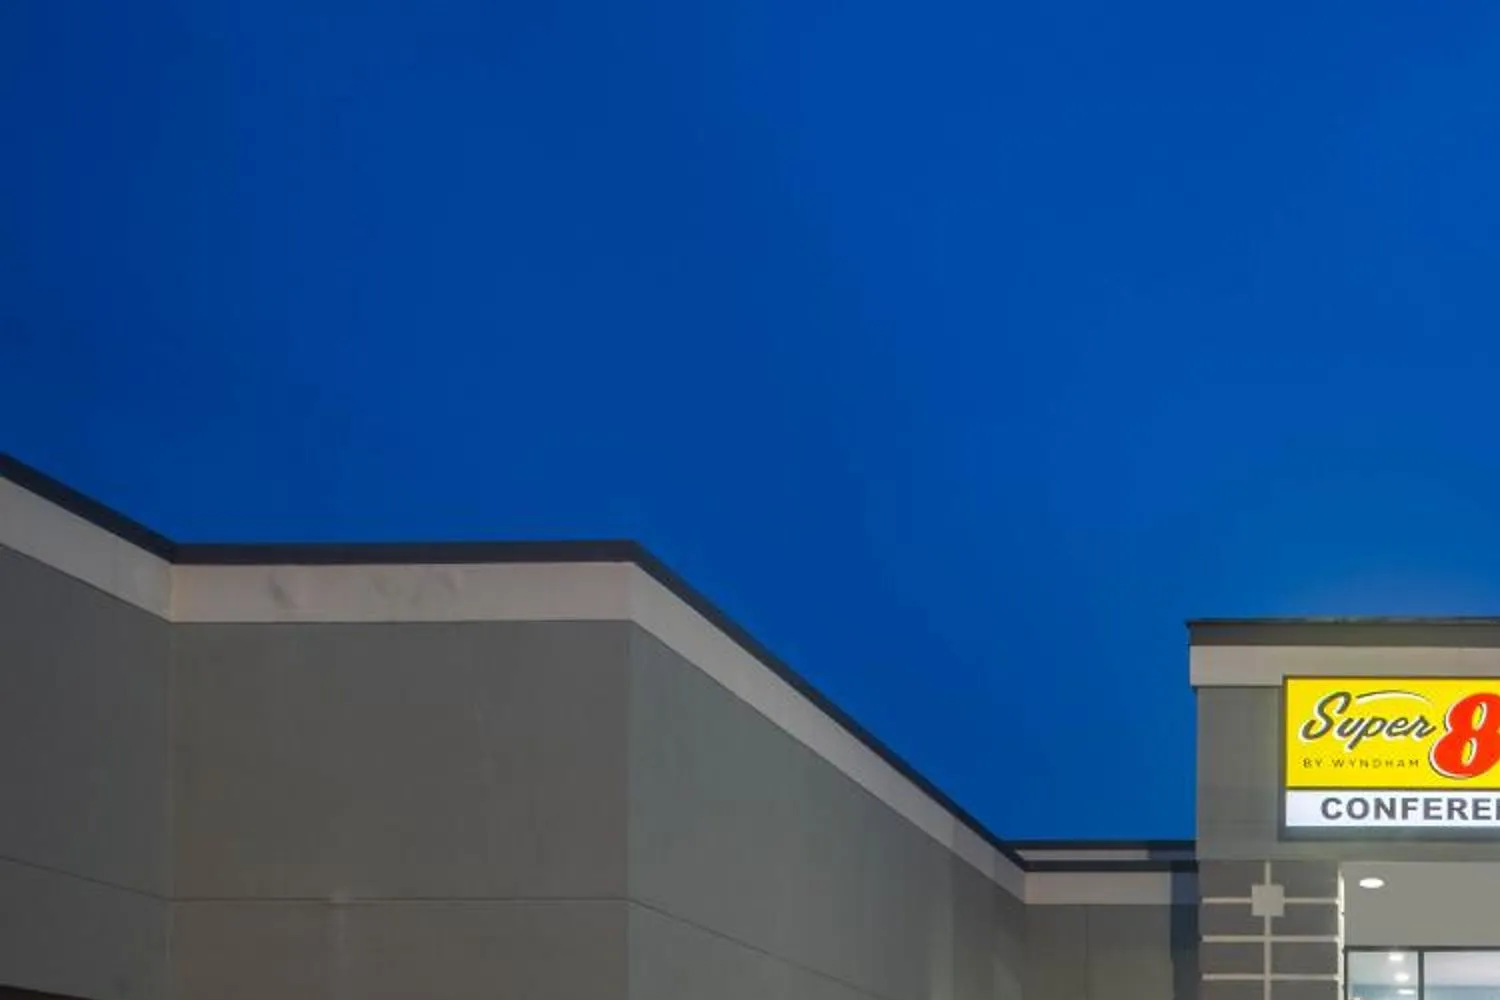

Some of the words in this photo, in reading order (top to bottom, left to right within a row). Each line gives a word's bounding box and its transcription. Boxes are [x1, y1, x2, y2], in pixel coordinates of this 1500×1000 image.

[1301, 691, 1436, 751] Super
[1303, 758, 1322, 768] BY
[1333, 758, 1420, 768] WYNDHAM
